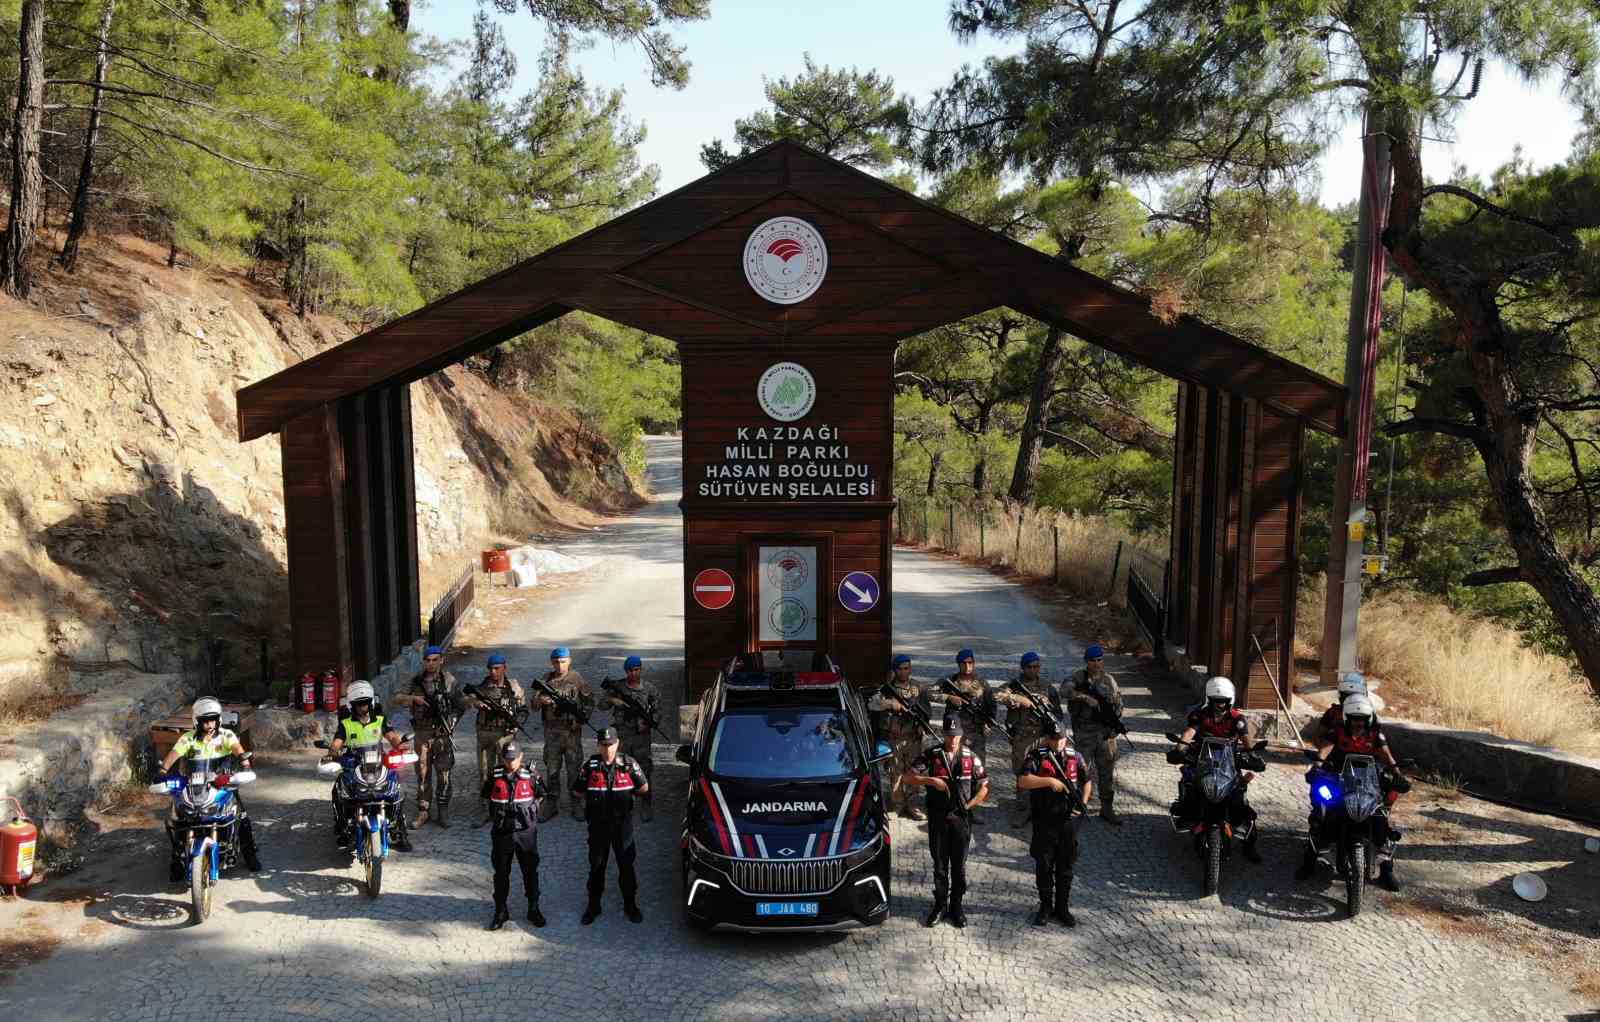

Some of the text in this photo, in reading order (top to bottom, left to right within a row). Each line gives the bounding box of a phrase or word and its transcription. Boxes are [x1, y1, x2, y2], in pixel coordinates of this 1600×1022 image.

[737, 424, 838, 441] KAZDAĞI
[725, 443, 849, 460] MİLLİ PARKI
[706, 461, 869, 478] HASAN BOĞULDU
[698, 479, 876, 499] SÜTÜVEN ŞELALESİ
[741, 801, 828, 814] JANDARMA
[759, 903, 770, 913] 10
[778, 903, 794, 913] JAA
